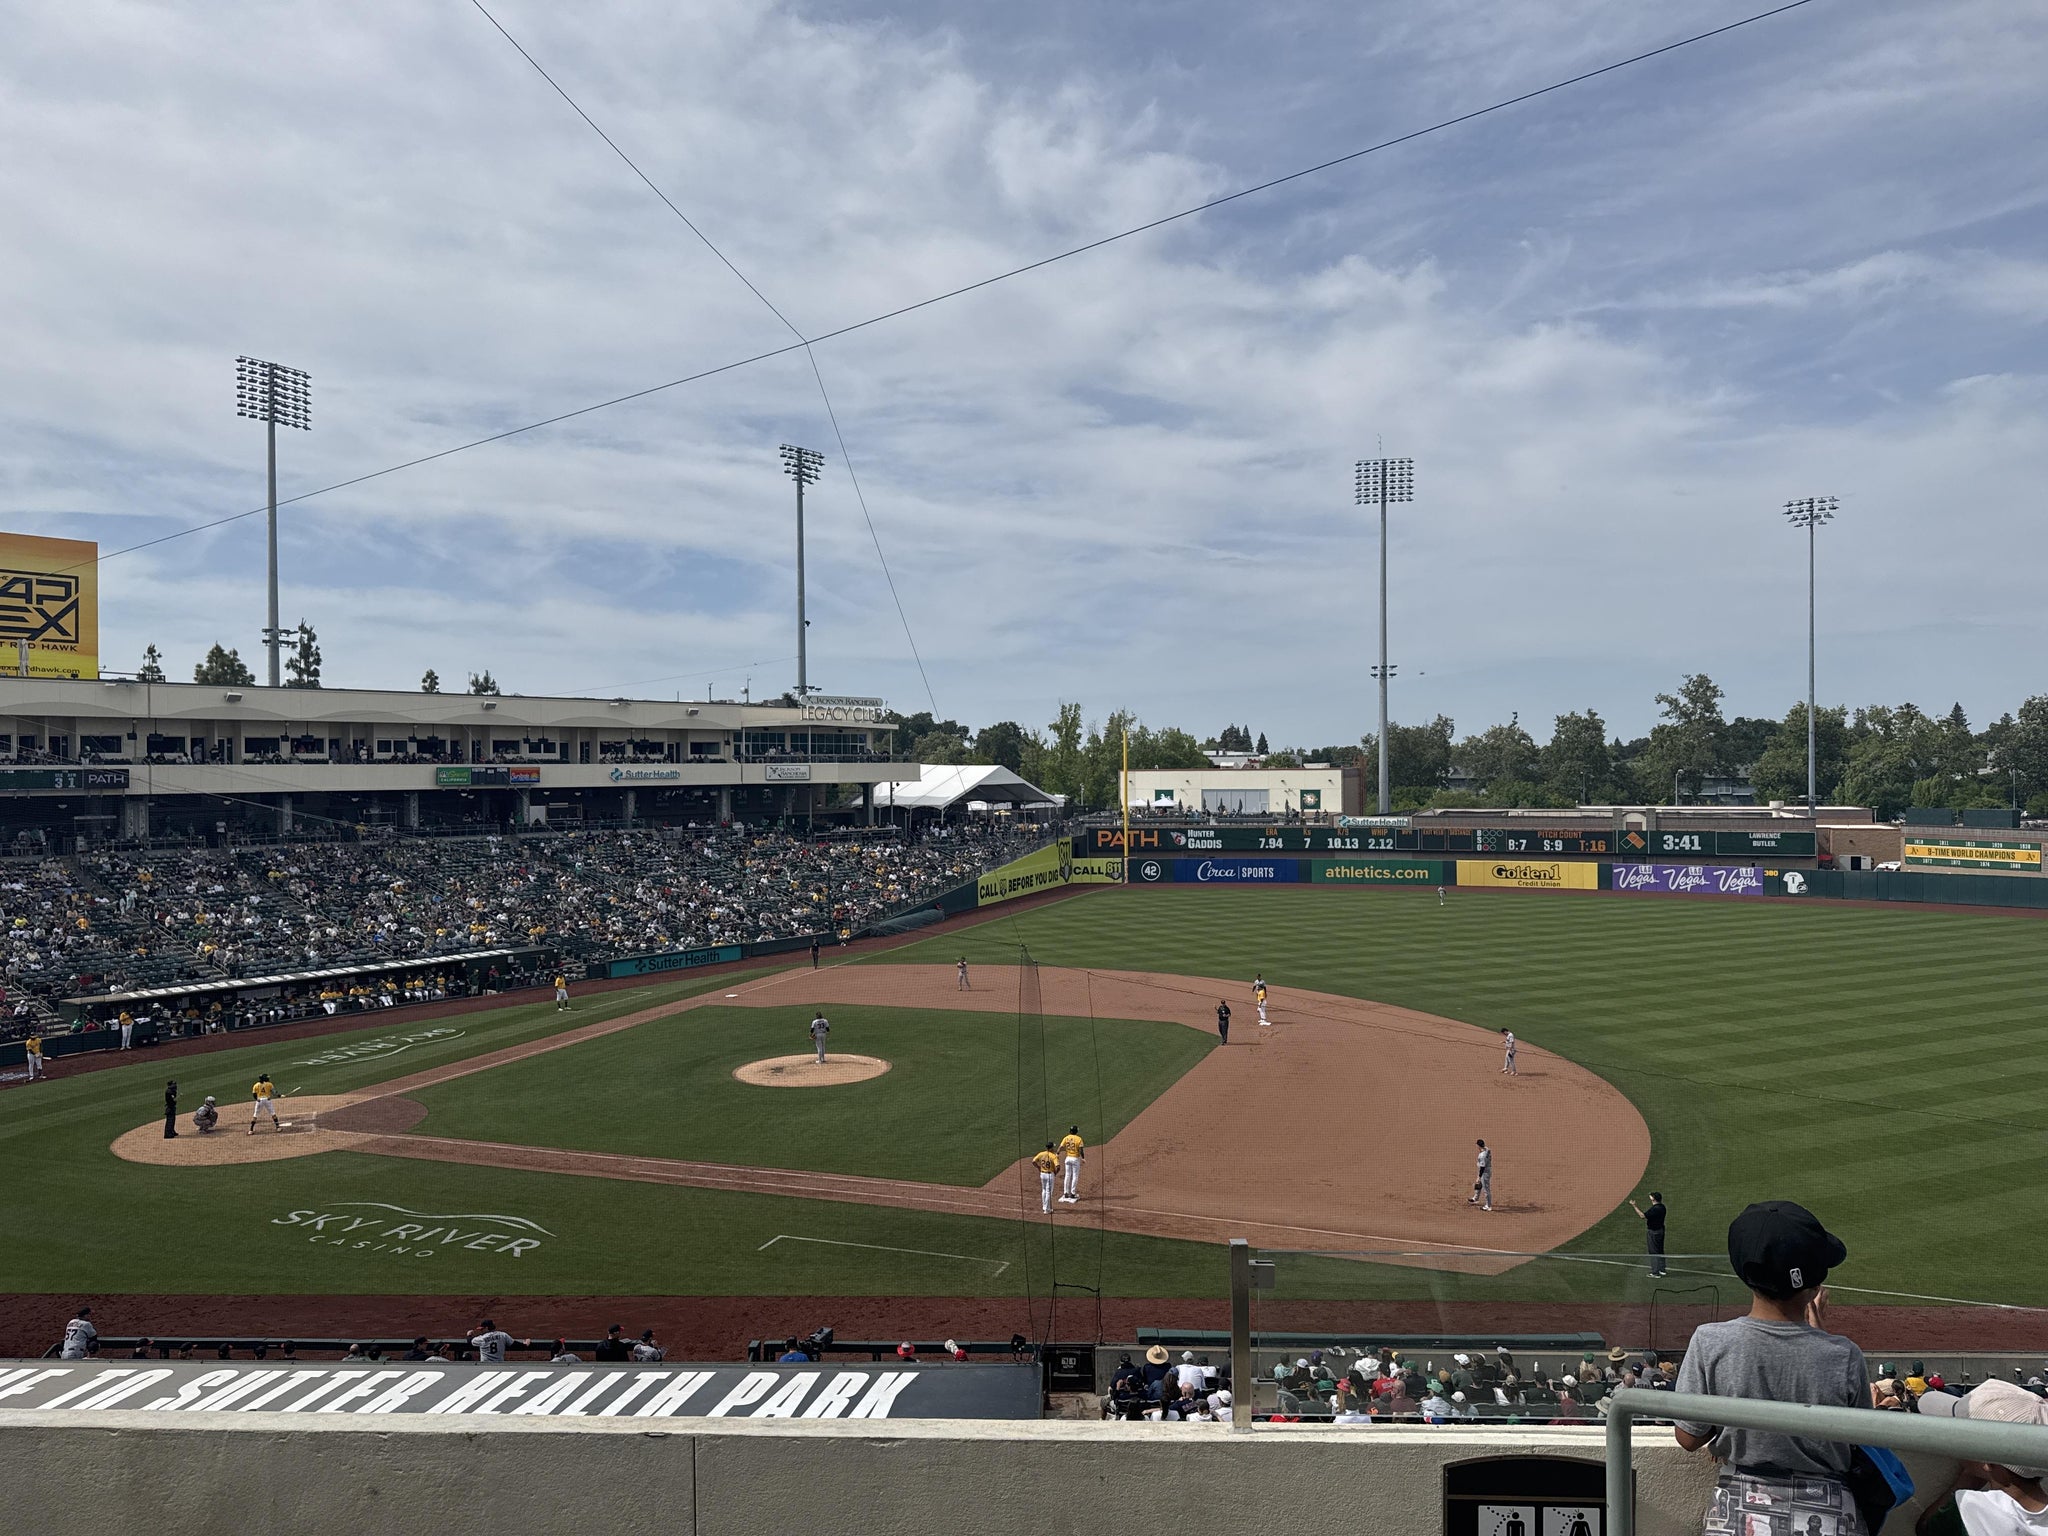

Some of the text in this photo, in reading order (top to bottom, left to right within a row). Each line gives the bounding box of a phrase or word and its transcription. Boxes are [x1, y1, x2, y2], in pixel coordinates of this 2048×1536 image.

[10, 641, 36, 650] RD
[41, 643, 78, 652] HAWK
[800, 705, 884, 722] LEGACY CLUB
[55, 777, 75, 788] 3 1
[88, 774, 125, 784] PATH
[1265, 828, 1279, 836] ERA
[1370, 828, 1389, 837] WHIP
[1537, 830, 1583, 839] PITCH COUNT
[1748, 832, 1782, 840] LAWRENCE
[1097, 830, 1160, 847] PATH
[1187, 838, 1223, 849] GADDIS
[1258, 837, 1284, 849] 7.94
[1304, 837, 1312, 849] 7
[1327, 837, 1360, 849] 10.13
[1368, 838, 1395, 850] 2.12
[1663, 834, 1702, 851] 3:41
[1508, 839, 1607, 852] B:7 S:9 T:16
[1951, 849, 1974, 858] WORLD
[1974, 850, 2016, 860] CHAMPIONS
[1073, 866, 1104, 875] CALL
[1144, 864, 1158, 876] 42
[1197, 860, 1275, 882] Circa SPORTS
[1325, 865, 1430, 881] athletics.com
[1613, 866, 1660, 890] Vegas
[1662, 868, 1711, 892] Vegas
[1713, 869, 1763, 894] Vegas
[979, 883, 999, 900] CALL
[1008, 875, 1034, 892] BEFORE
[1035, 871, 1048, 887] YOU
[1048, 870, 1059, 884] DIG
[648, 950, 720, 971] Sutter Health
[271, 1210, 541, 1258] SKY RIVER
[309, 1235, 435, 1258] CASINO
[489, 1341, 498, 1354] 8
[139, 1369, 446, 1414] SUTTER
[424, 1371, 718, 1417] HEALTH
[706, 1372, 920, 1419] PARK
